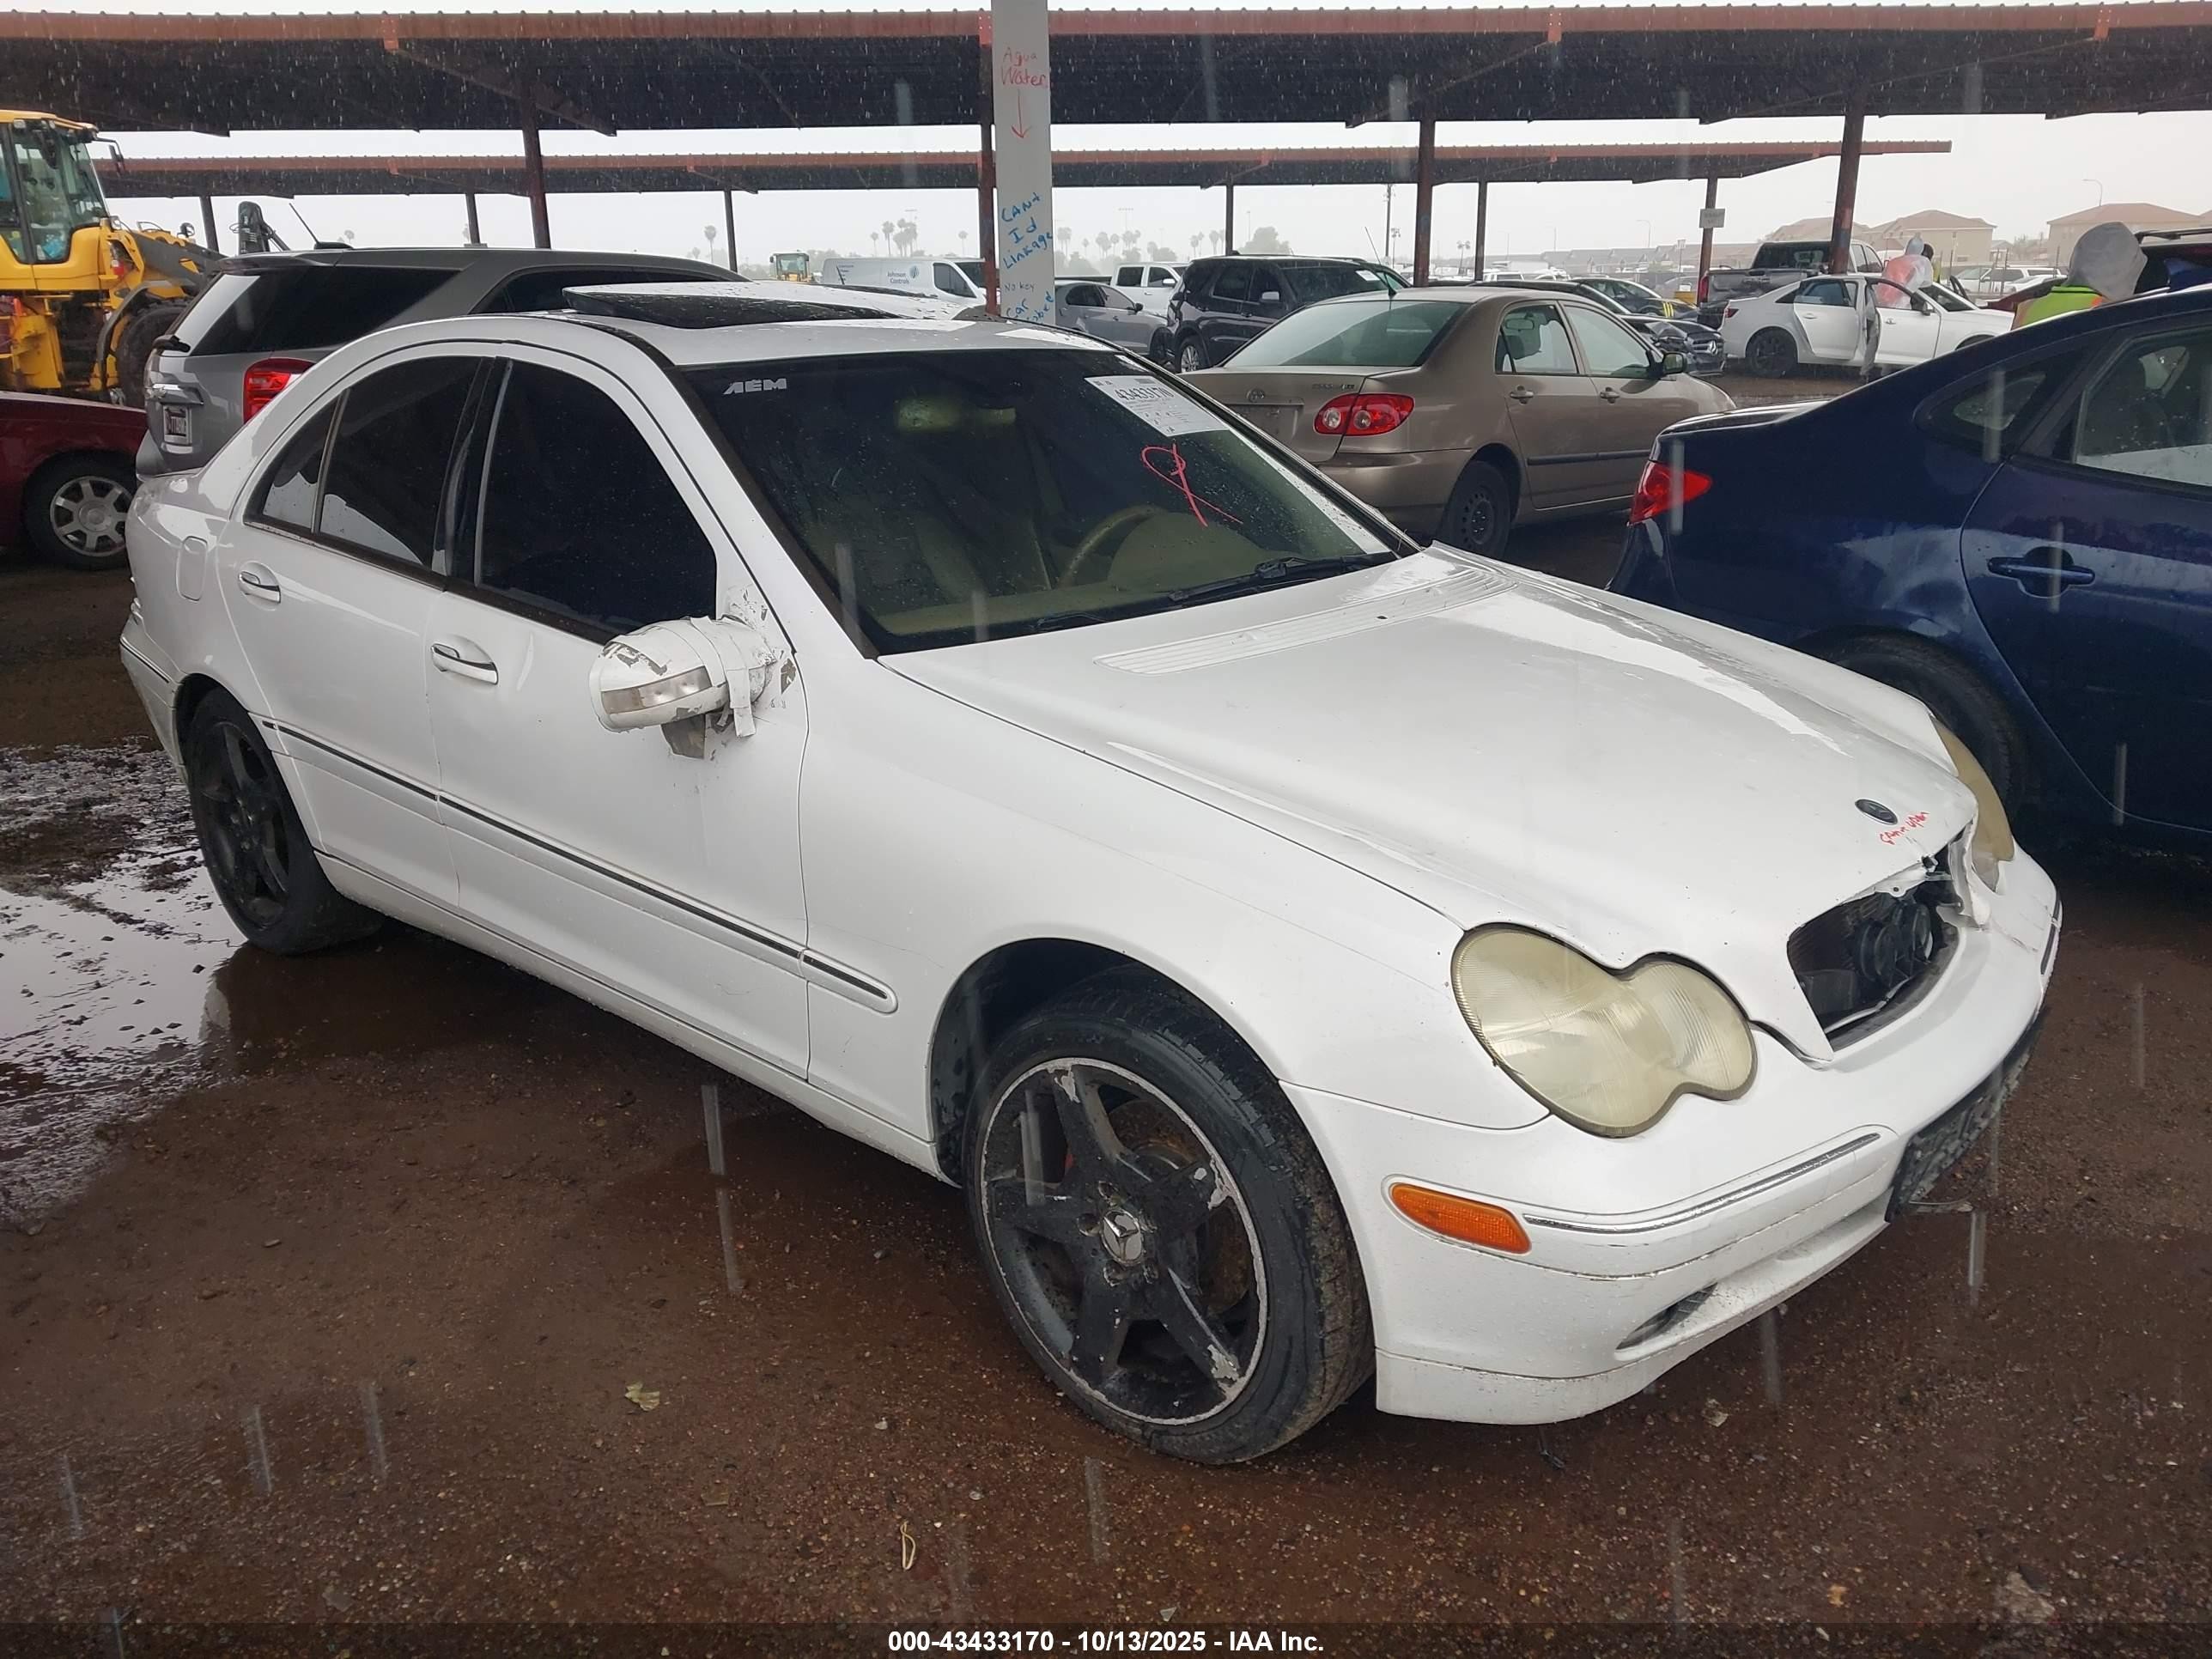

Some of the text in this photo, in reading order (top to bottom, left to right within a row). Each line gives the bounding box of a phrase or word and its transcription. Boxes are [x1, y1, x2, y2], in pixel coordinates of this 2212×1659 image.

[1003, 46, 1038, 67] Agua
[1000, 66, 1046, 87] Water
[722, 378, 787, 395] AEM
[1115, 386, 1174, 400] 43433170
